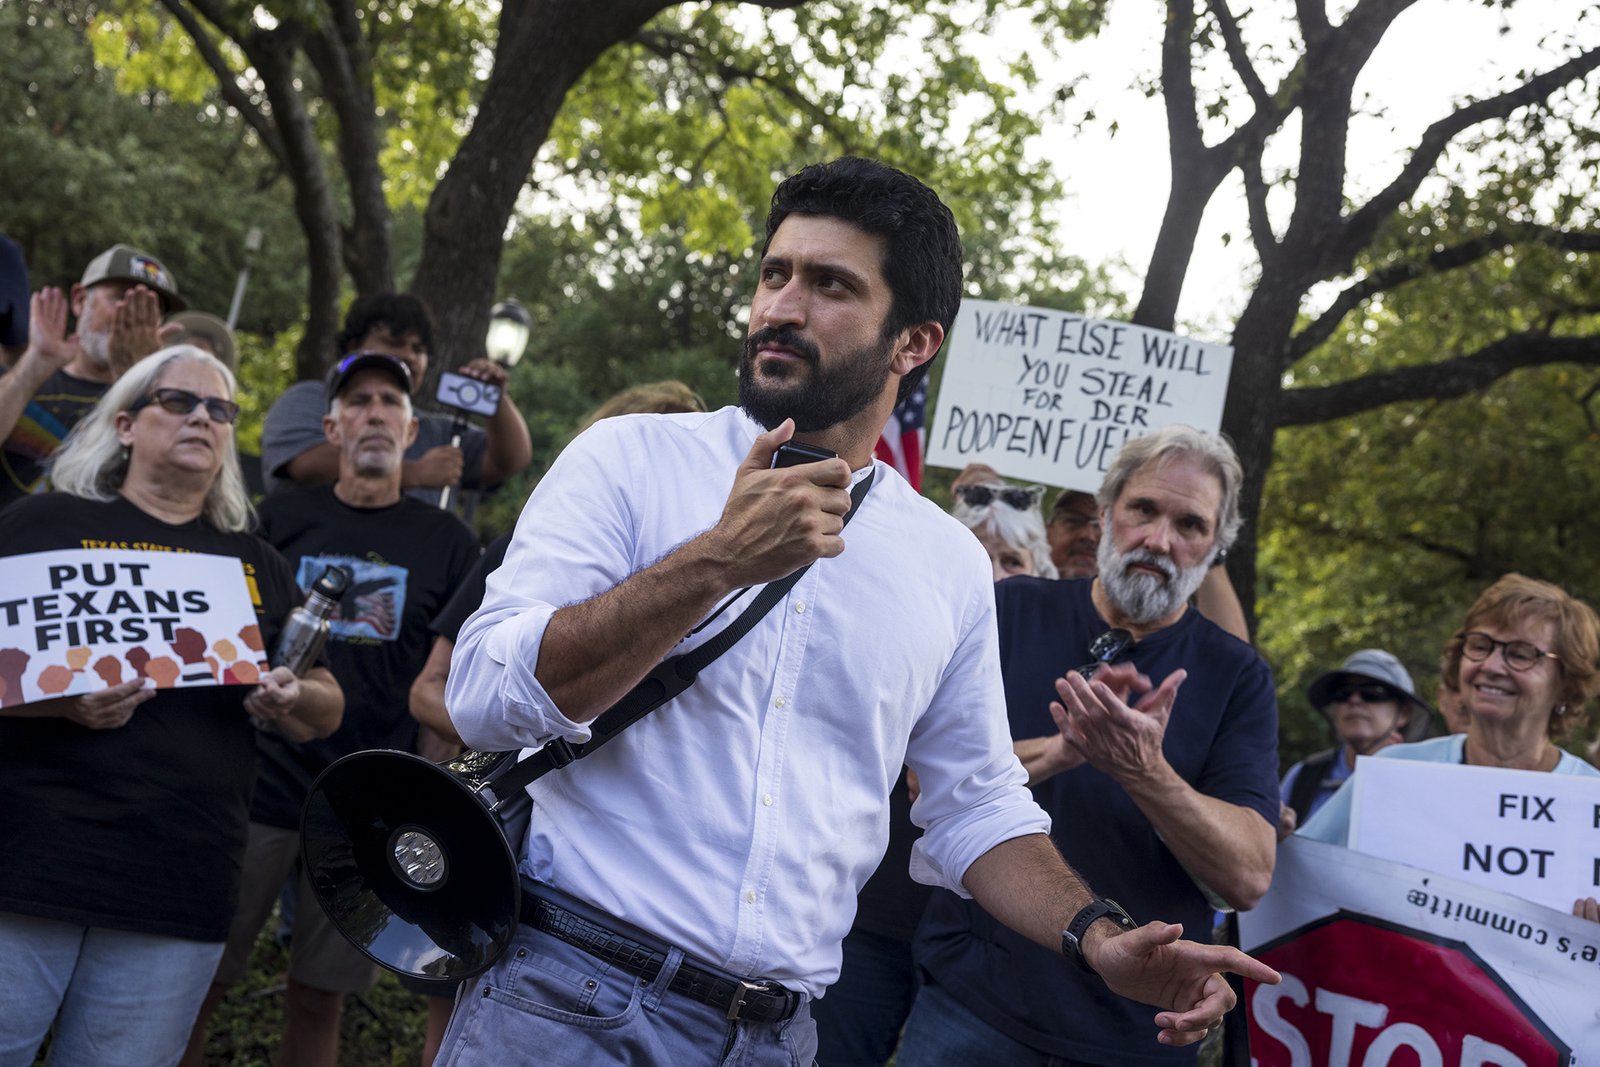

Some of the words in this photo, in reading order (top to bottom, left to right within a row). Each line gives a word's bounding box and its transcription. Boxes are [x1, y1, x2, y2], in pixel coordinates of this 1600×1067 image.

[975, 311, 1048, 347] WHAT
[1057, 318, 1128, 360] ELSE
[1017, 354, 1070, 388] YOU
[1080, 368, 1173, 407] STEAL
[1022, 388, 1062, 412] FOR
[1089, 399, 1149, 427] DER
[49, 563, 150, 589] PUT
[0, 590, 210, 627] TEXANS
[35, 617, 181, 651] FIRST
[1499, 794, 1556, 822] FIX
[1463, 843, 1555, 878] NOT
[1251, 971, 1530, 1067] ST
